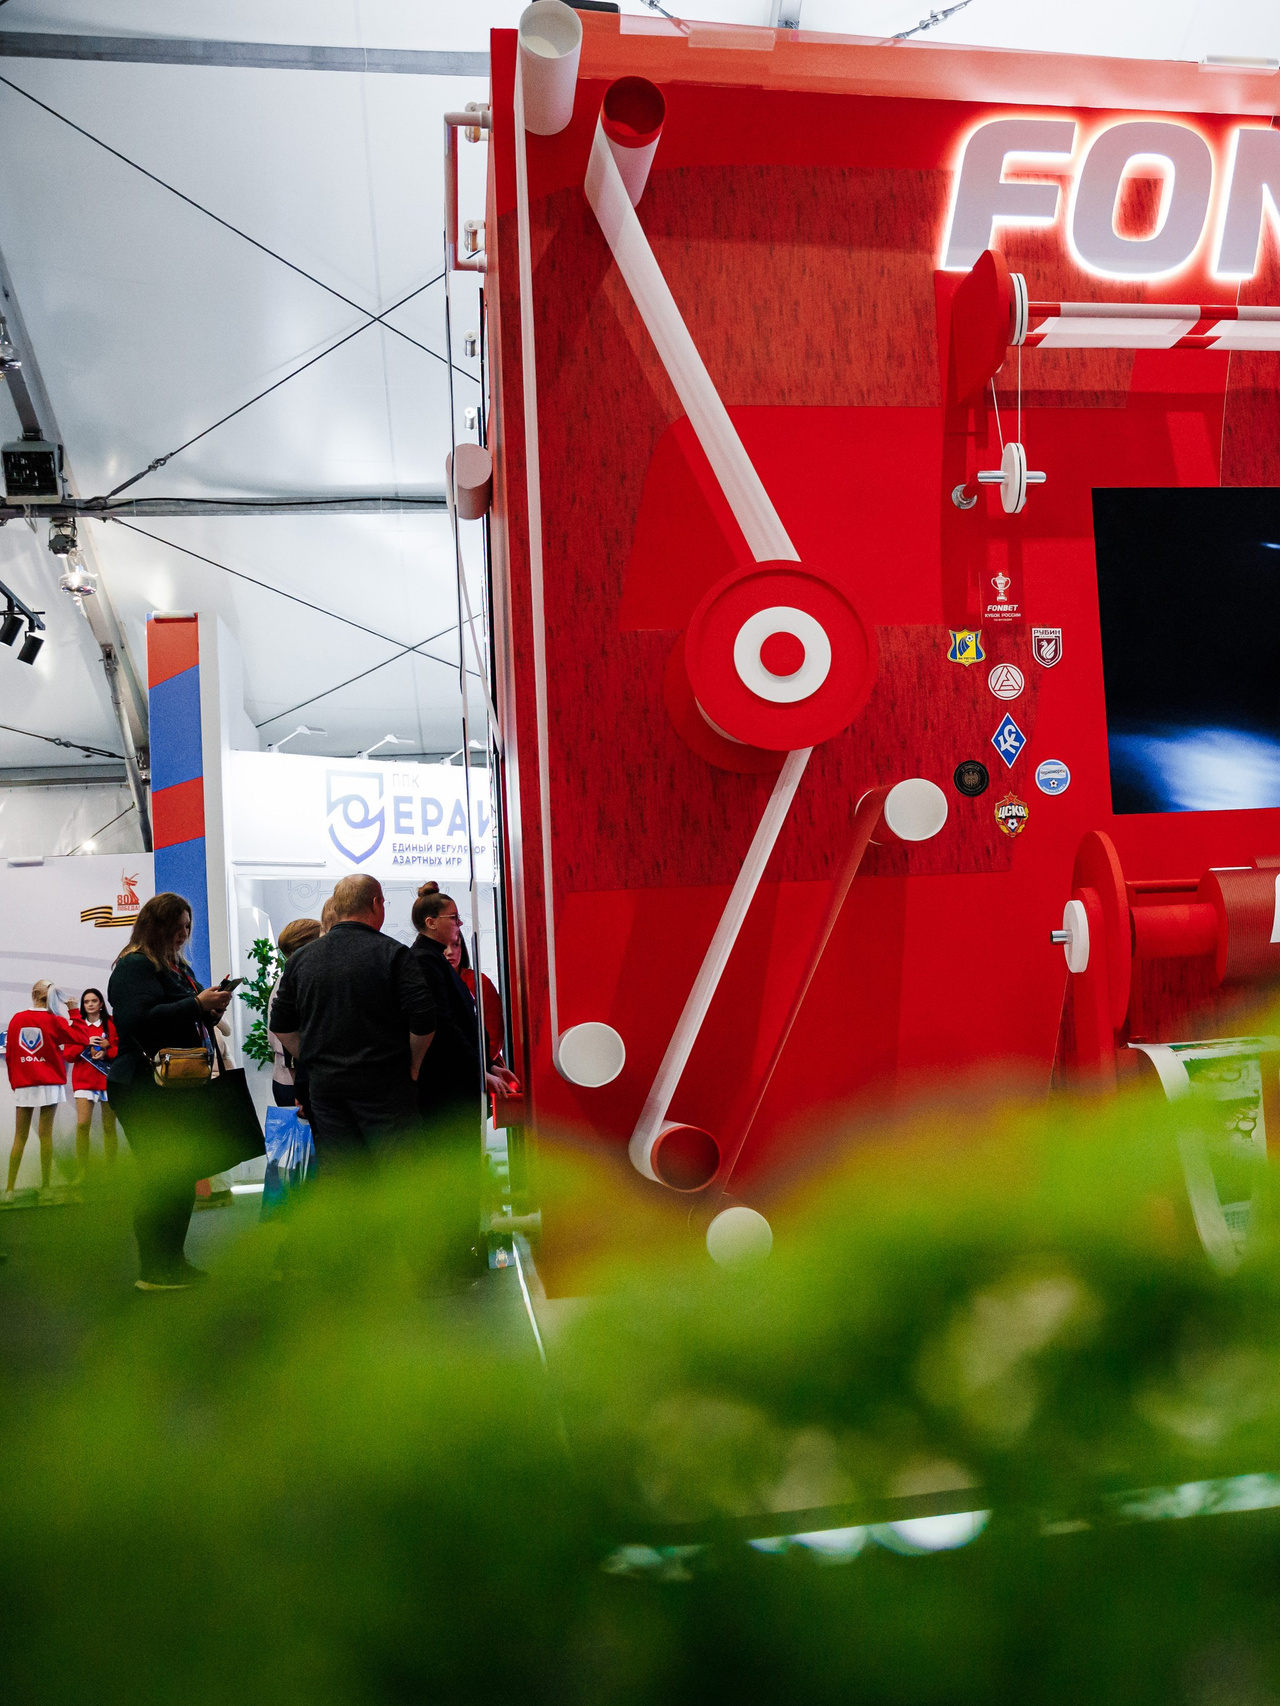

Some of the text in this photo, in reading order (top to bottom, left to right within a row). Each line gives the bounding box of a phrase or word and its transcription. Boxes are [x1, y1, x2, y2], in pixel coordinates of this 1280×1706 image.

[987, 604, 1018, 612] FONBET
[392, 773, 420, 788] ППК
[998, 805, 1026, 819] ЦСКА
[392, 842, 486, 855] ЕДИНЫЙ РЕГУЛЯОР
[392, 855, 462, 867] АЗАРТНЫХ ИГР
